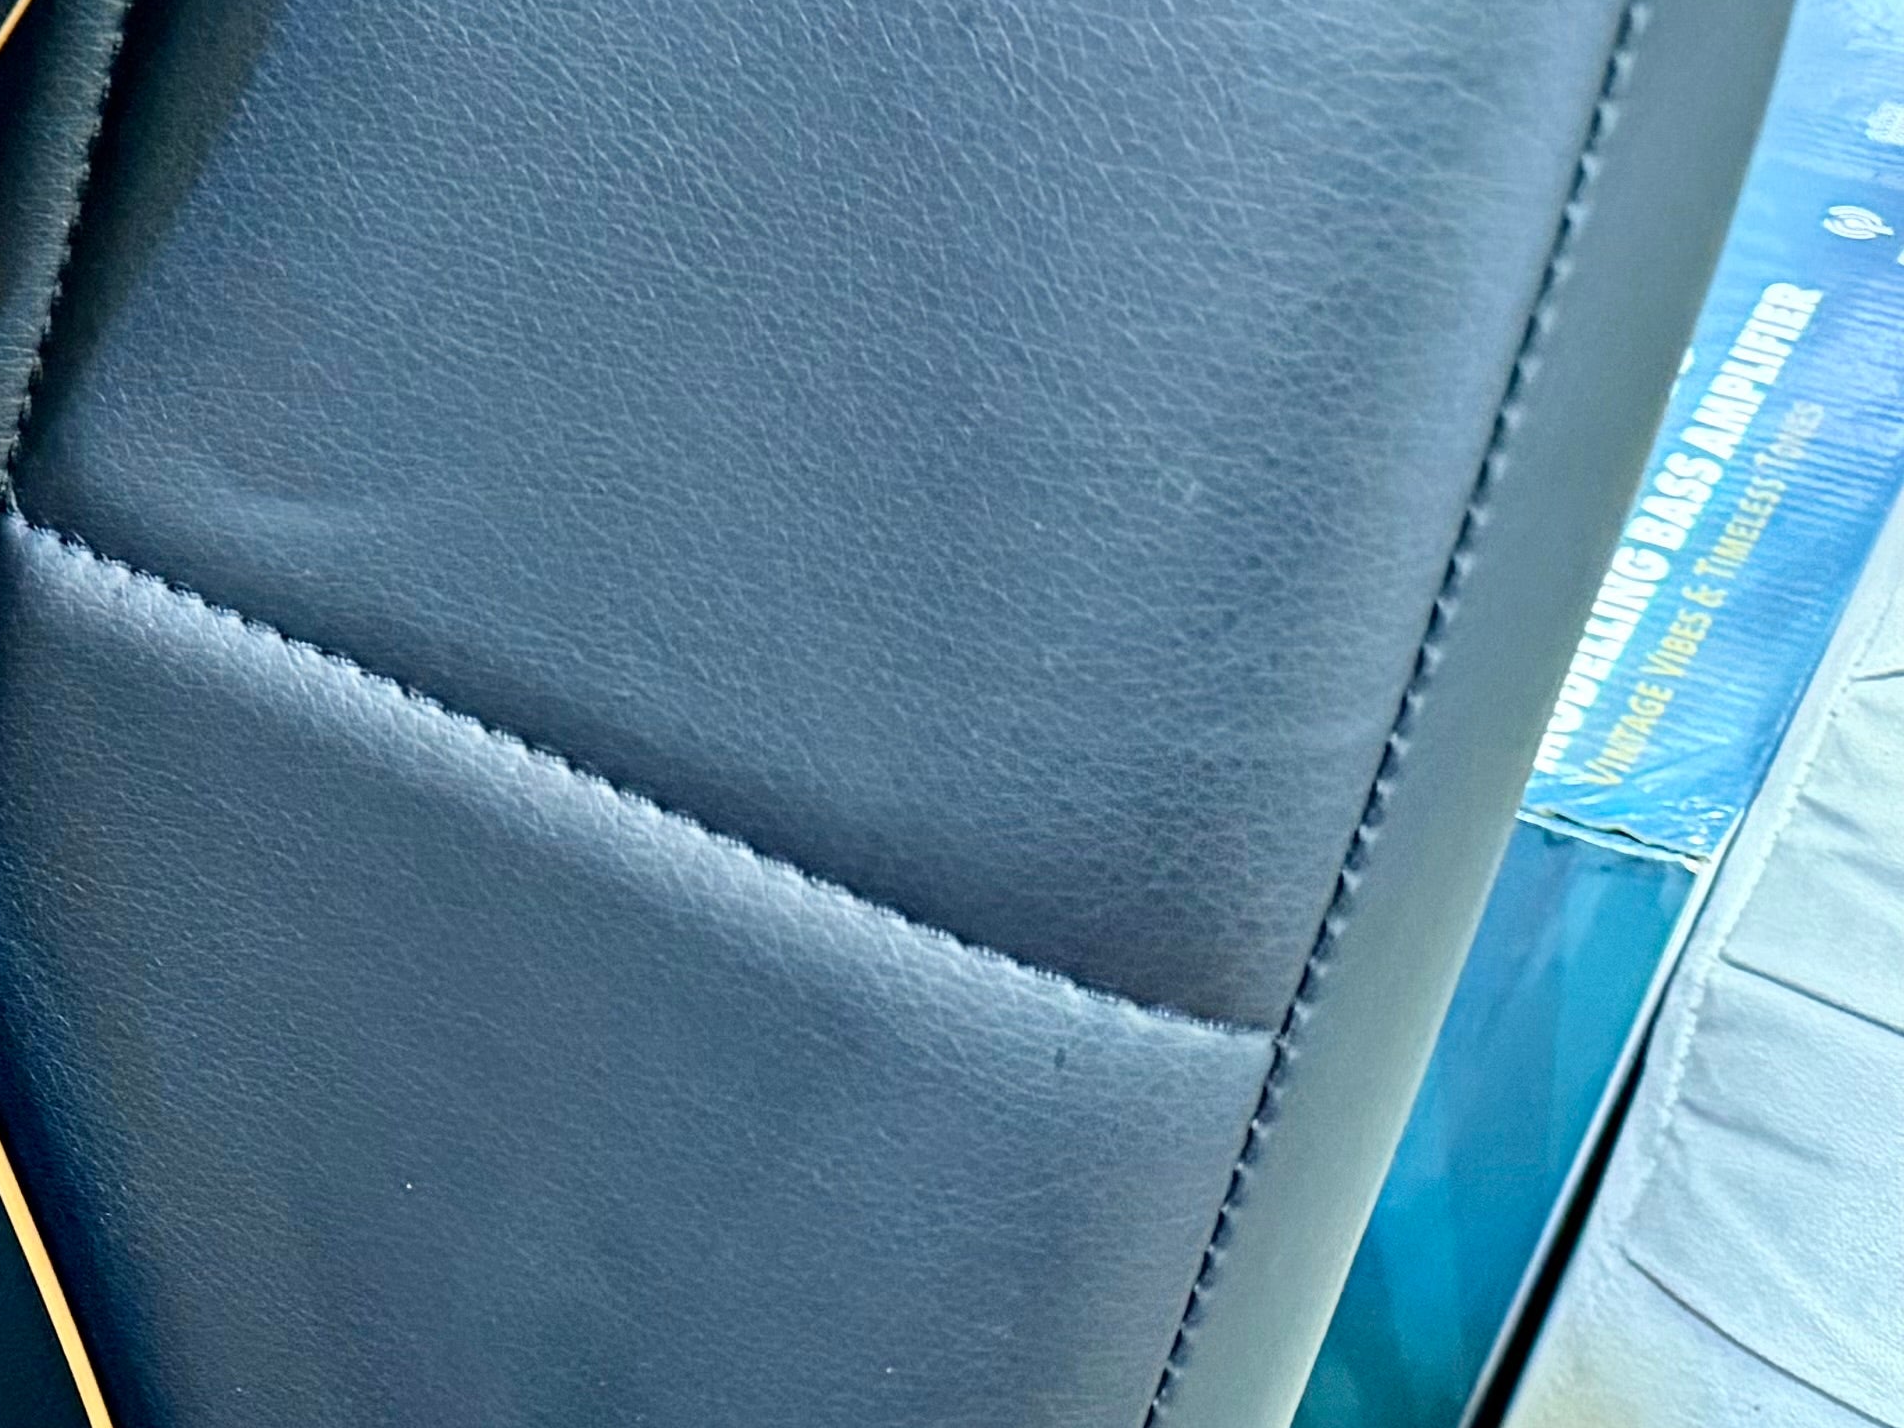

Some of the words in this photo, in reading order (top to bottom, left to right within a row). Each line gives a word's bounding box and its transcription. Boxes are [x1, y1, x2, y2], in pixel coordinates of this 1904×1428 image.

[1623, 452, 1723, 551] BASS
[1679, 282, 1824, 461] AMPLIFIER
[1753, 400, 1825, 470] TONES
[1693, 475, 1788, 580] TIMELESS
[1681, 583, 1728, 608] &
[1638, 608, 1713, 678] VIBES
[1582, 680, 1675, 786] VINTAGE
